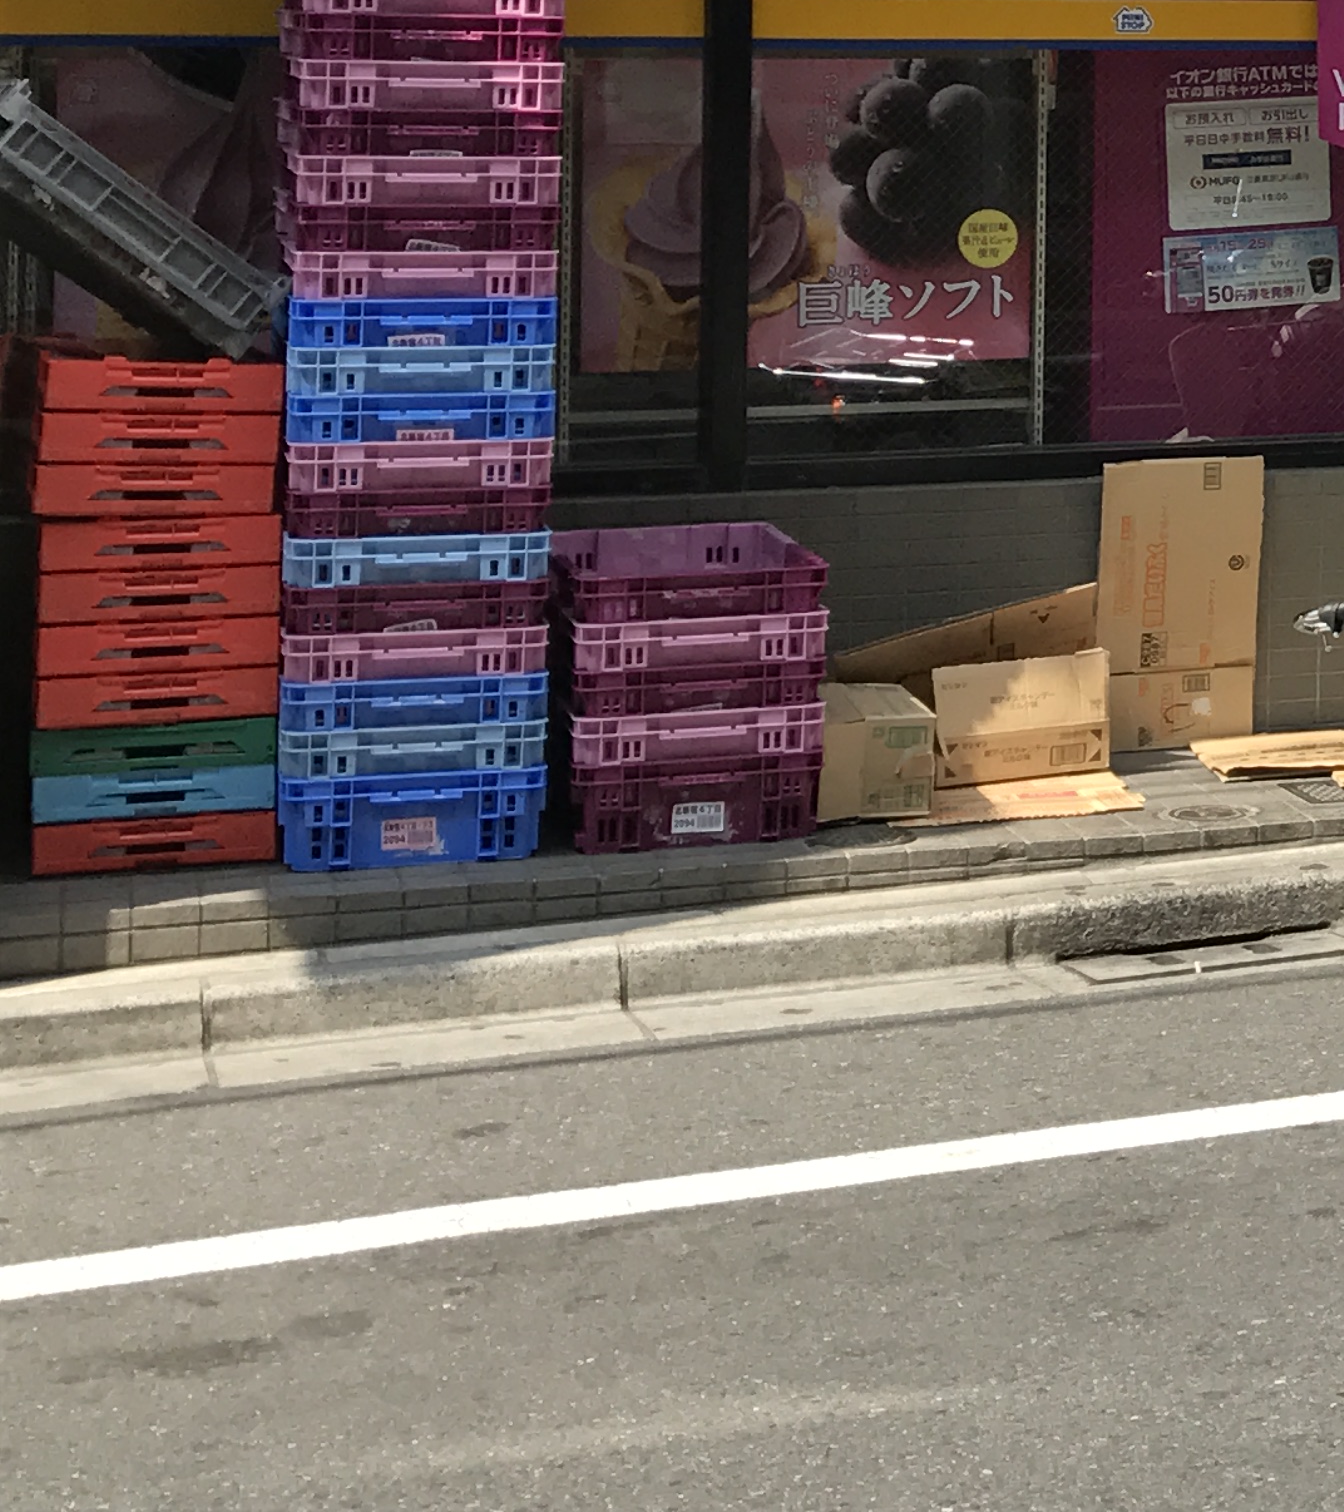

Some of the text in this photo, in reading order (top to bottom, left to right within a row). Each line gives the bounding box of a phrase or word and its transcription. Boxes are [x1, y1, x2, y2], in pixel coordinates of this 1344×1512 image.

[797, 274, 1015, 328] 巨峰ソフト
